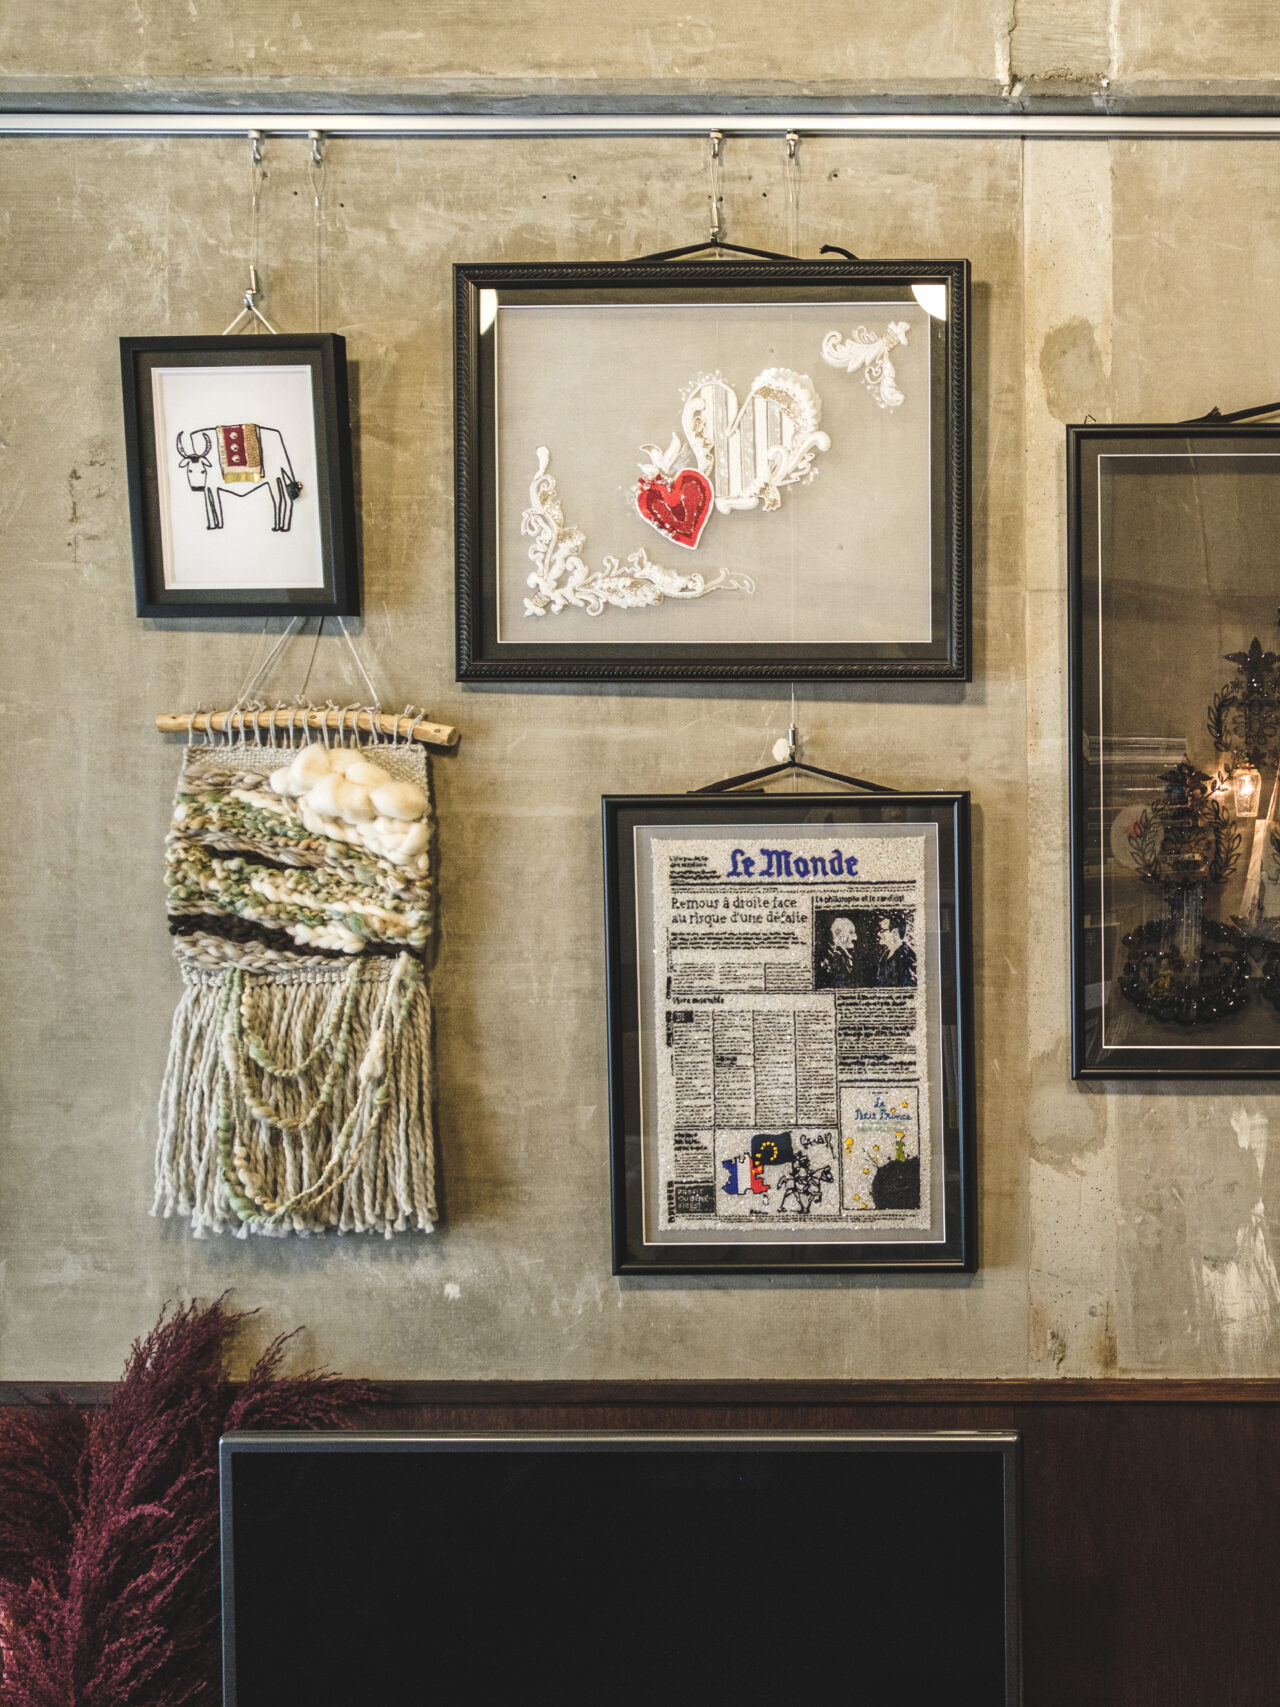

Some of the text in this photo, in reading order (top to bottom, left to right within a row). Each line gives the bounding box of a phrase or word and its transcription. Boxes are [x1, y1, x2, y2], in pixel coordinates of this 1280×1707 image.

[726, 848, 859, 878] Le Monde
[671, 896, 797, 910] Remous à droite face
[671, 911, 808, 927] au risque d'une défaite
